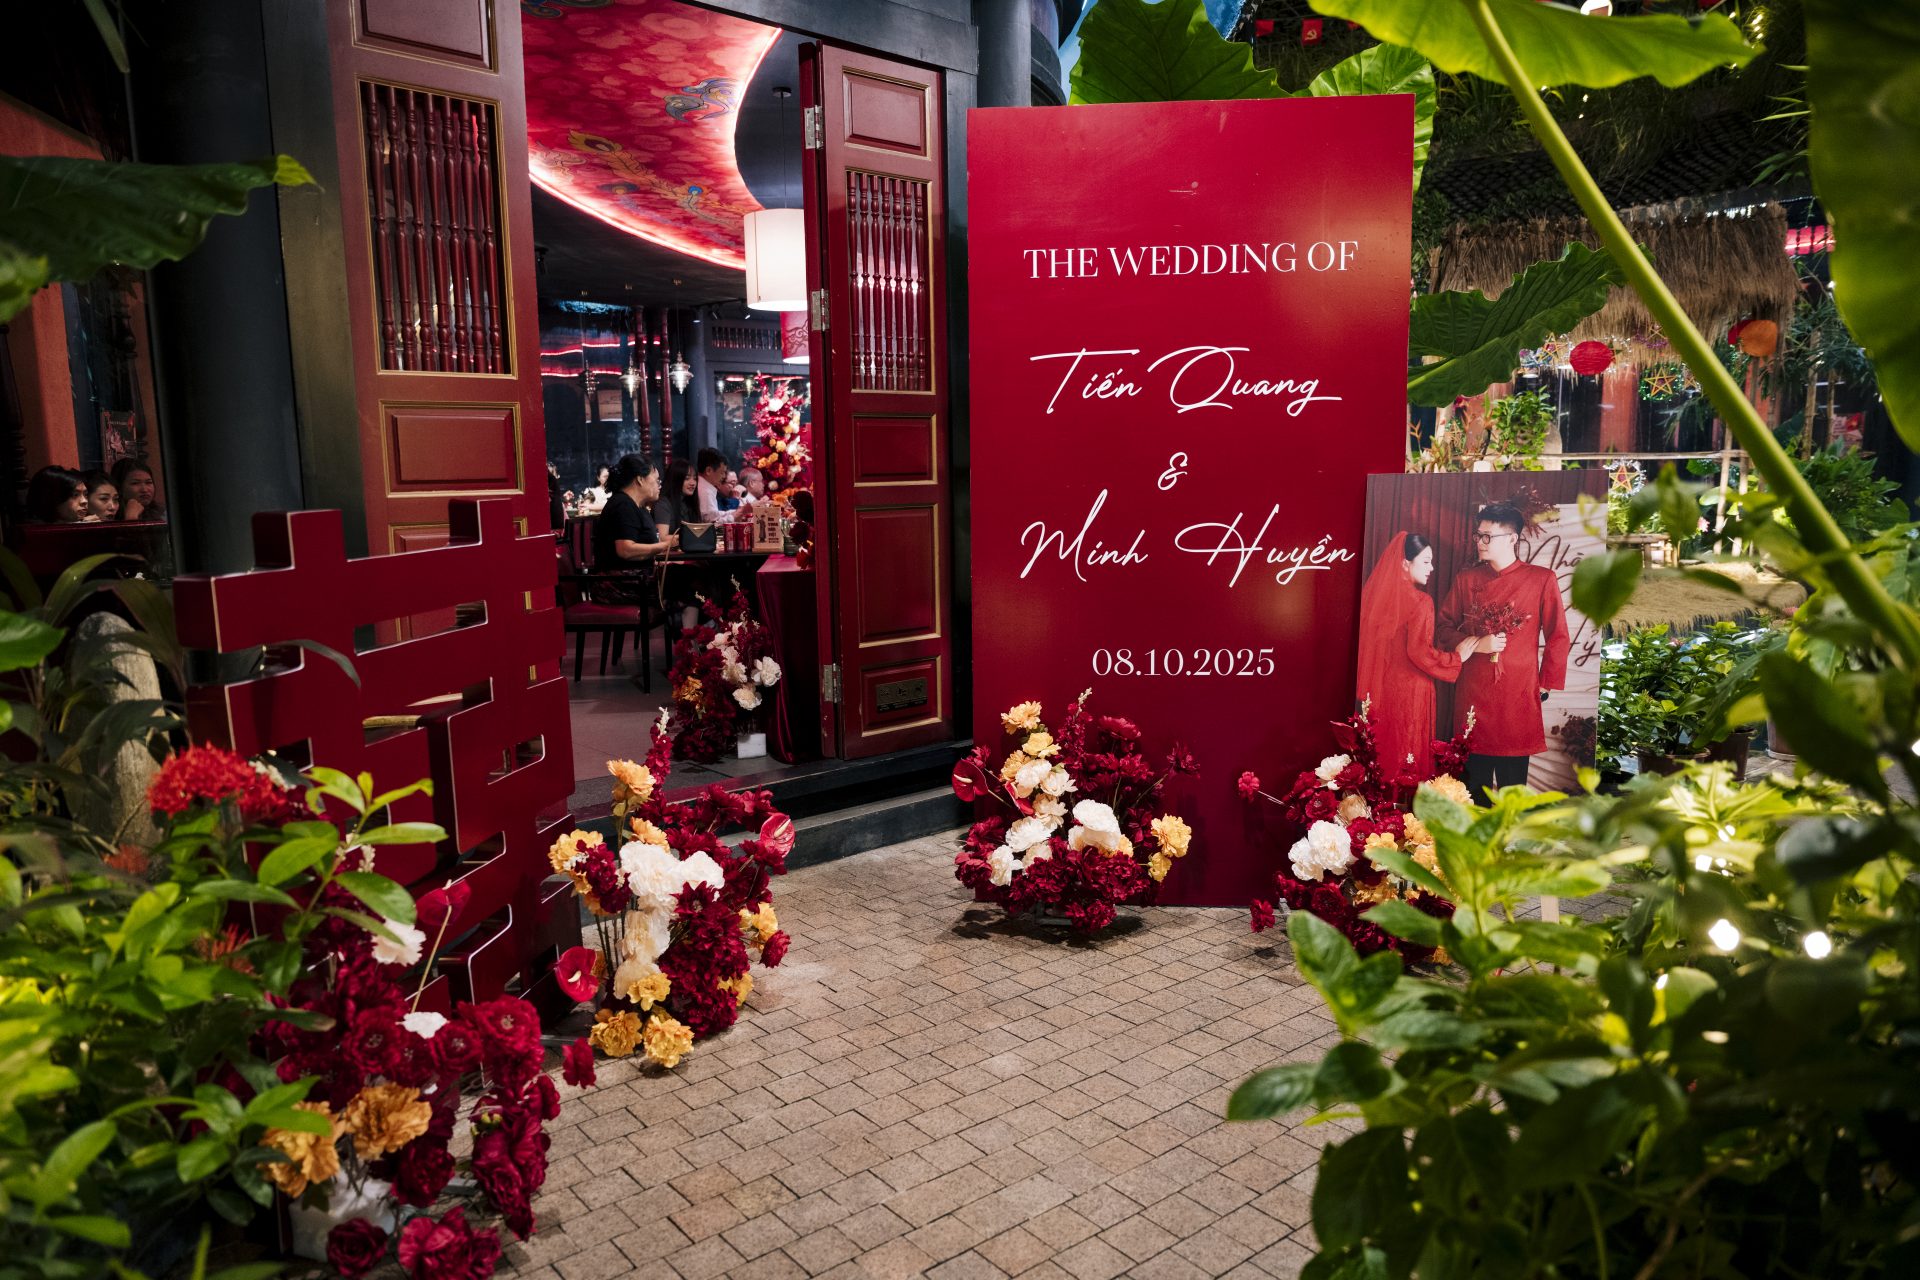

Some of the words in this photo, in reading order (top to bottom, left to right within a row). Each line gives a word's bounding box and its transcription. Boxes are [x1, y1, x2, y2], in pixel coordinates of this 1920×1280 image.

[1023, 247, 1099, 280] THE
[1107, 242, 1298, 277] WEDDING
[1307, 239, 1359, 272] OF
[1029, 347, 1143, 415] Tiến
[1146, 345, 1343, 417] Quang
[1157, 451, 1188, 491] &
[1019, 488, 1150, 583] Minh
[1174, 503, 1356, 588] Huyền
[1092, 647, 1276, 677] 08.10.2025
